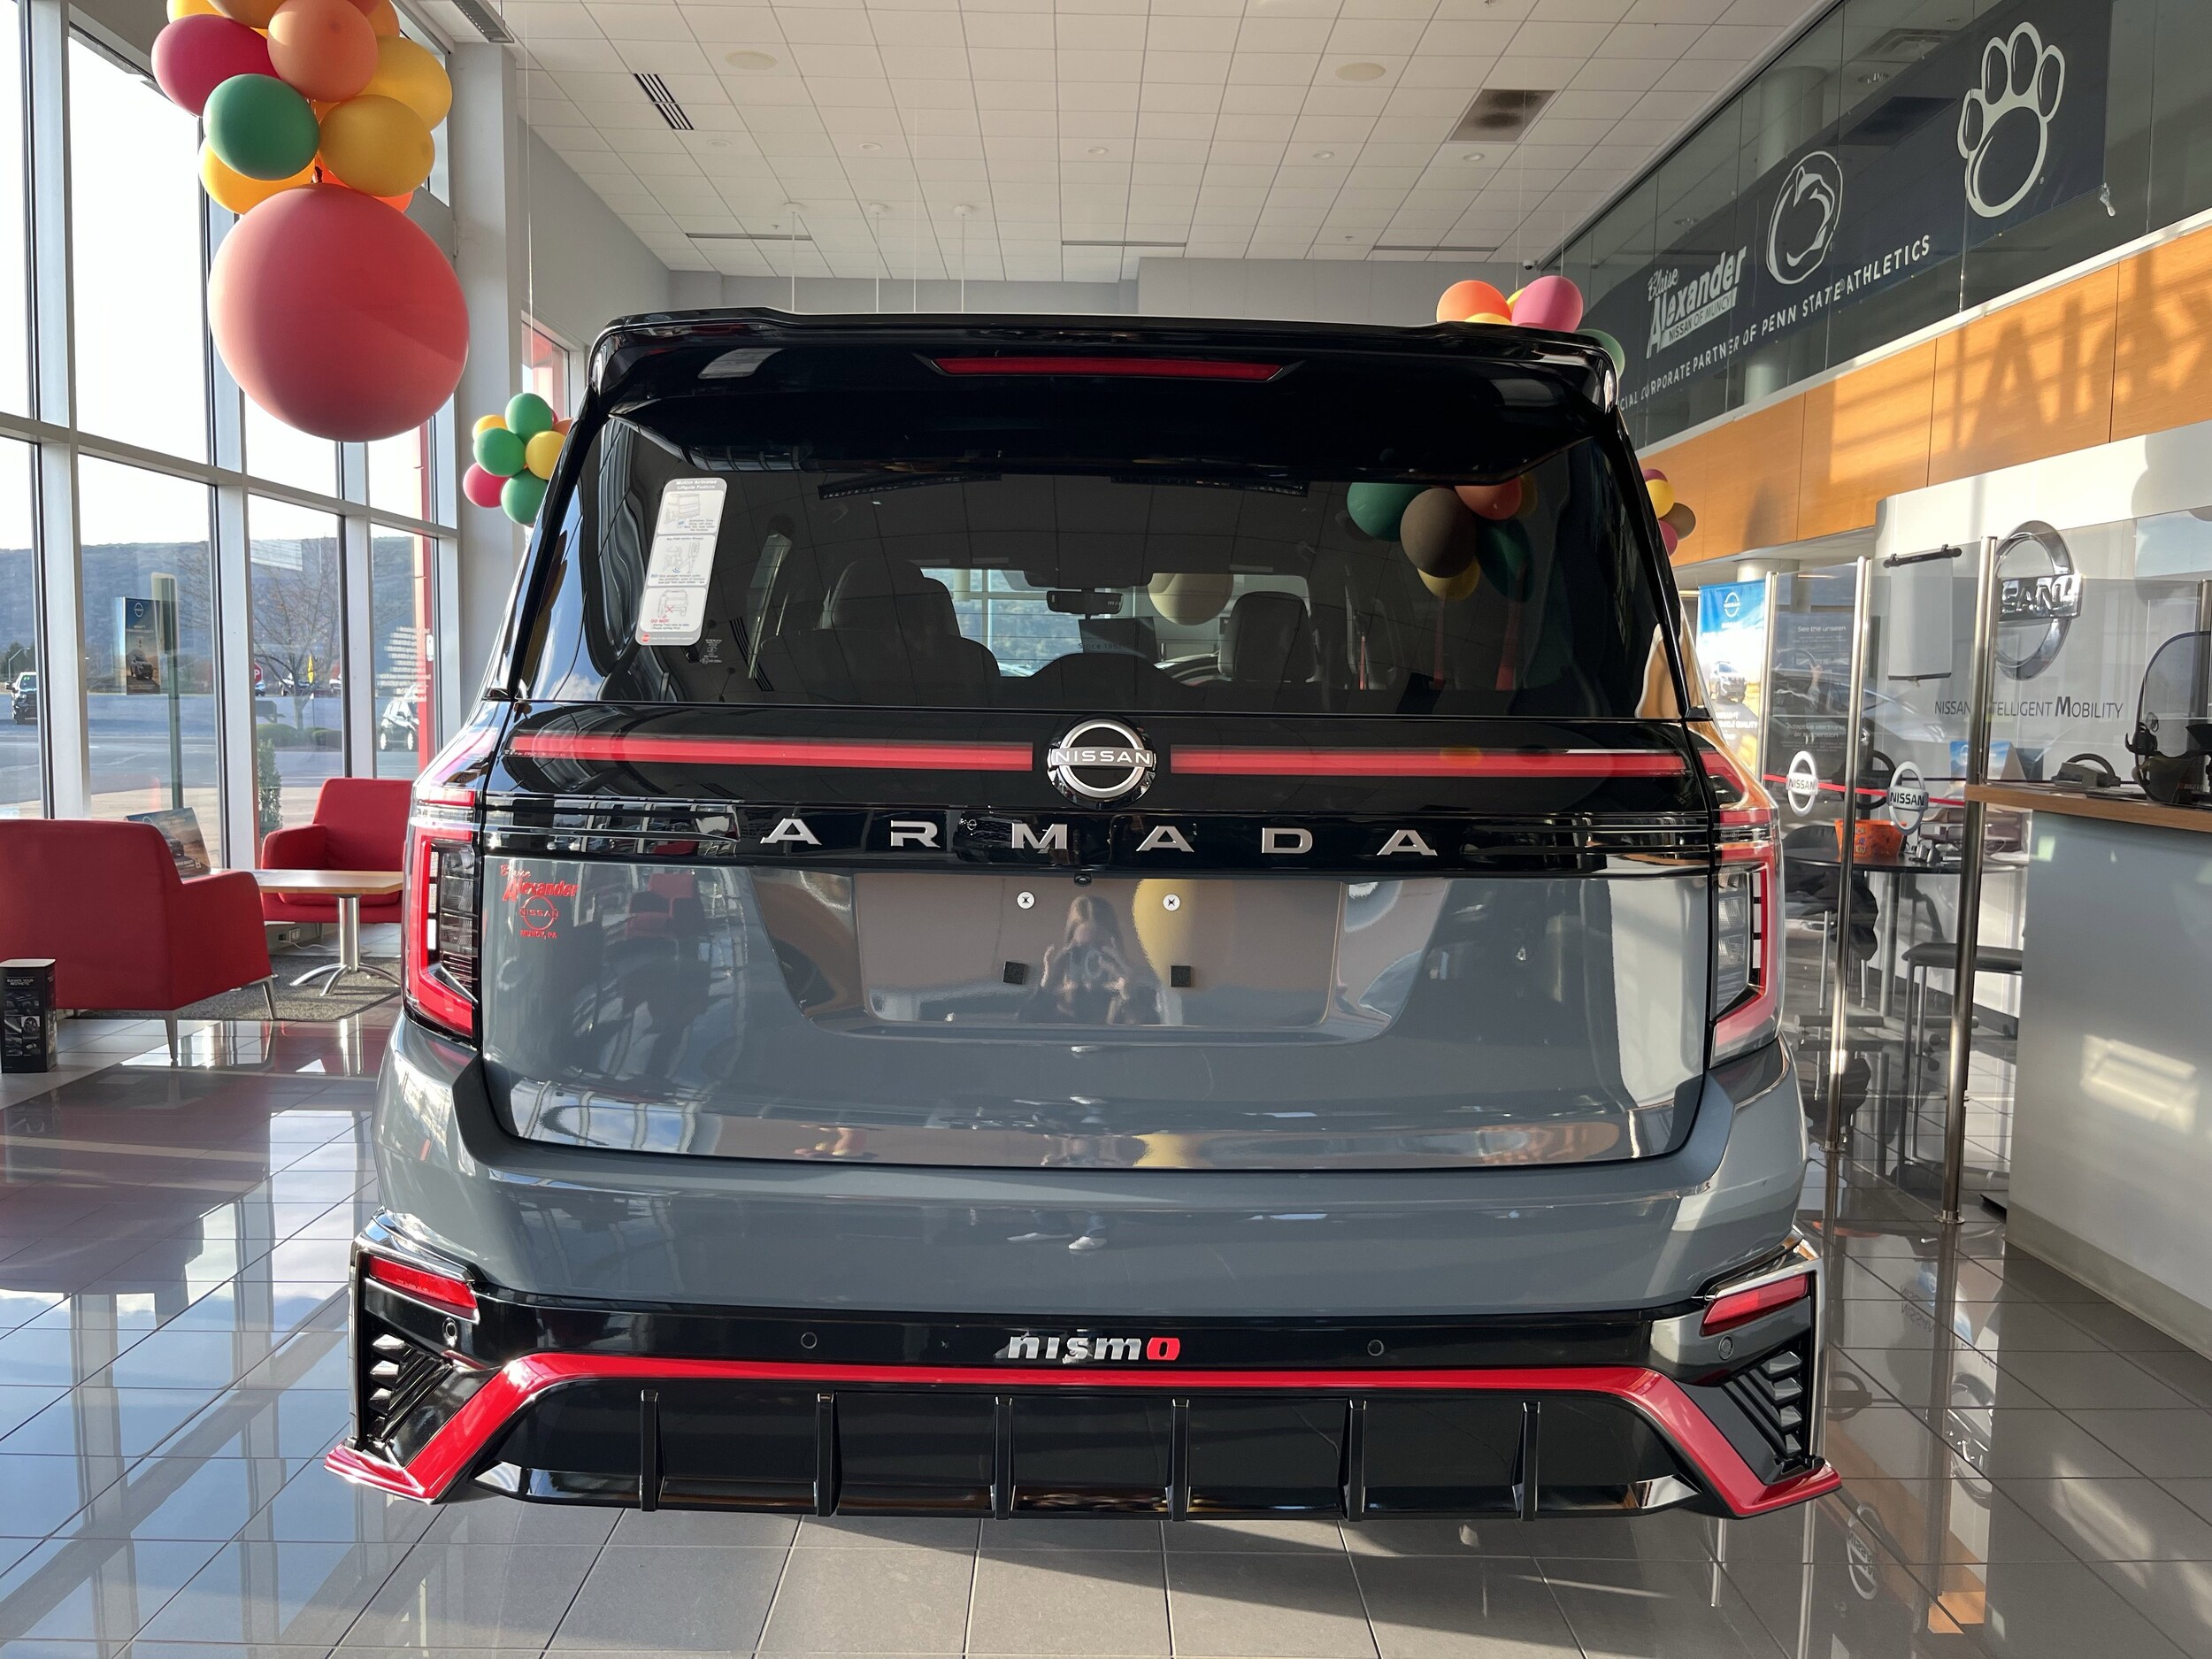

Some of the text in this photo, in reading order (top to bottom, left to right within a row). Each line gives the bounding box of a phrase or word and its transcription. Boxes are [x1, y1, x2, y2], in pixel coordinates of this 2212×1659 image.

[1647, 268, 1678, 302] Blaise
[1646, 245, 1747, 359] Alexander
[1640, 361, 1691, 401] CORPORATE
[1693, 335, 1740, 373] PARTNER
[1742, 324, 1757, 346] OF
[1761, 304, 1796, 336] PENN
[1846, 234, 1931, 295] ATHLETICS
[1669, 294, 1732, 342] NISSAN OF MUNCY
[1992, 701, 2053, 717] TELLIGENT
[2055, 695, 2124, 718] MOBILITY
[1055, 750, 1150, 764] NISSAN
[1788, 778, 1816, 790] NISSAN
[1890, 791, 1924, 806] NISSAN
[760, 818, 1439, 856] ARMADA
[502, 878, 580, 902] Alexander
[518, 909, 559, 918] NISSAN
[1007, 1336, 1181, 1361] nismo
